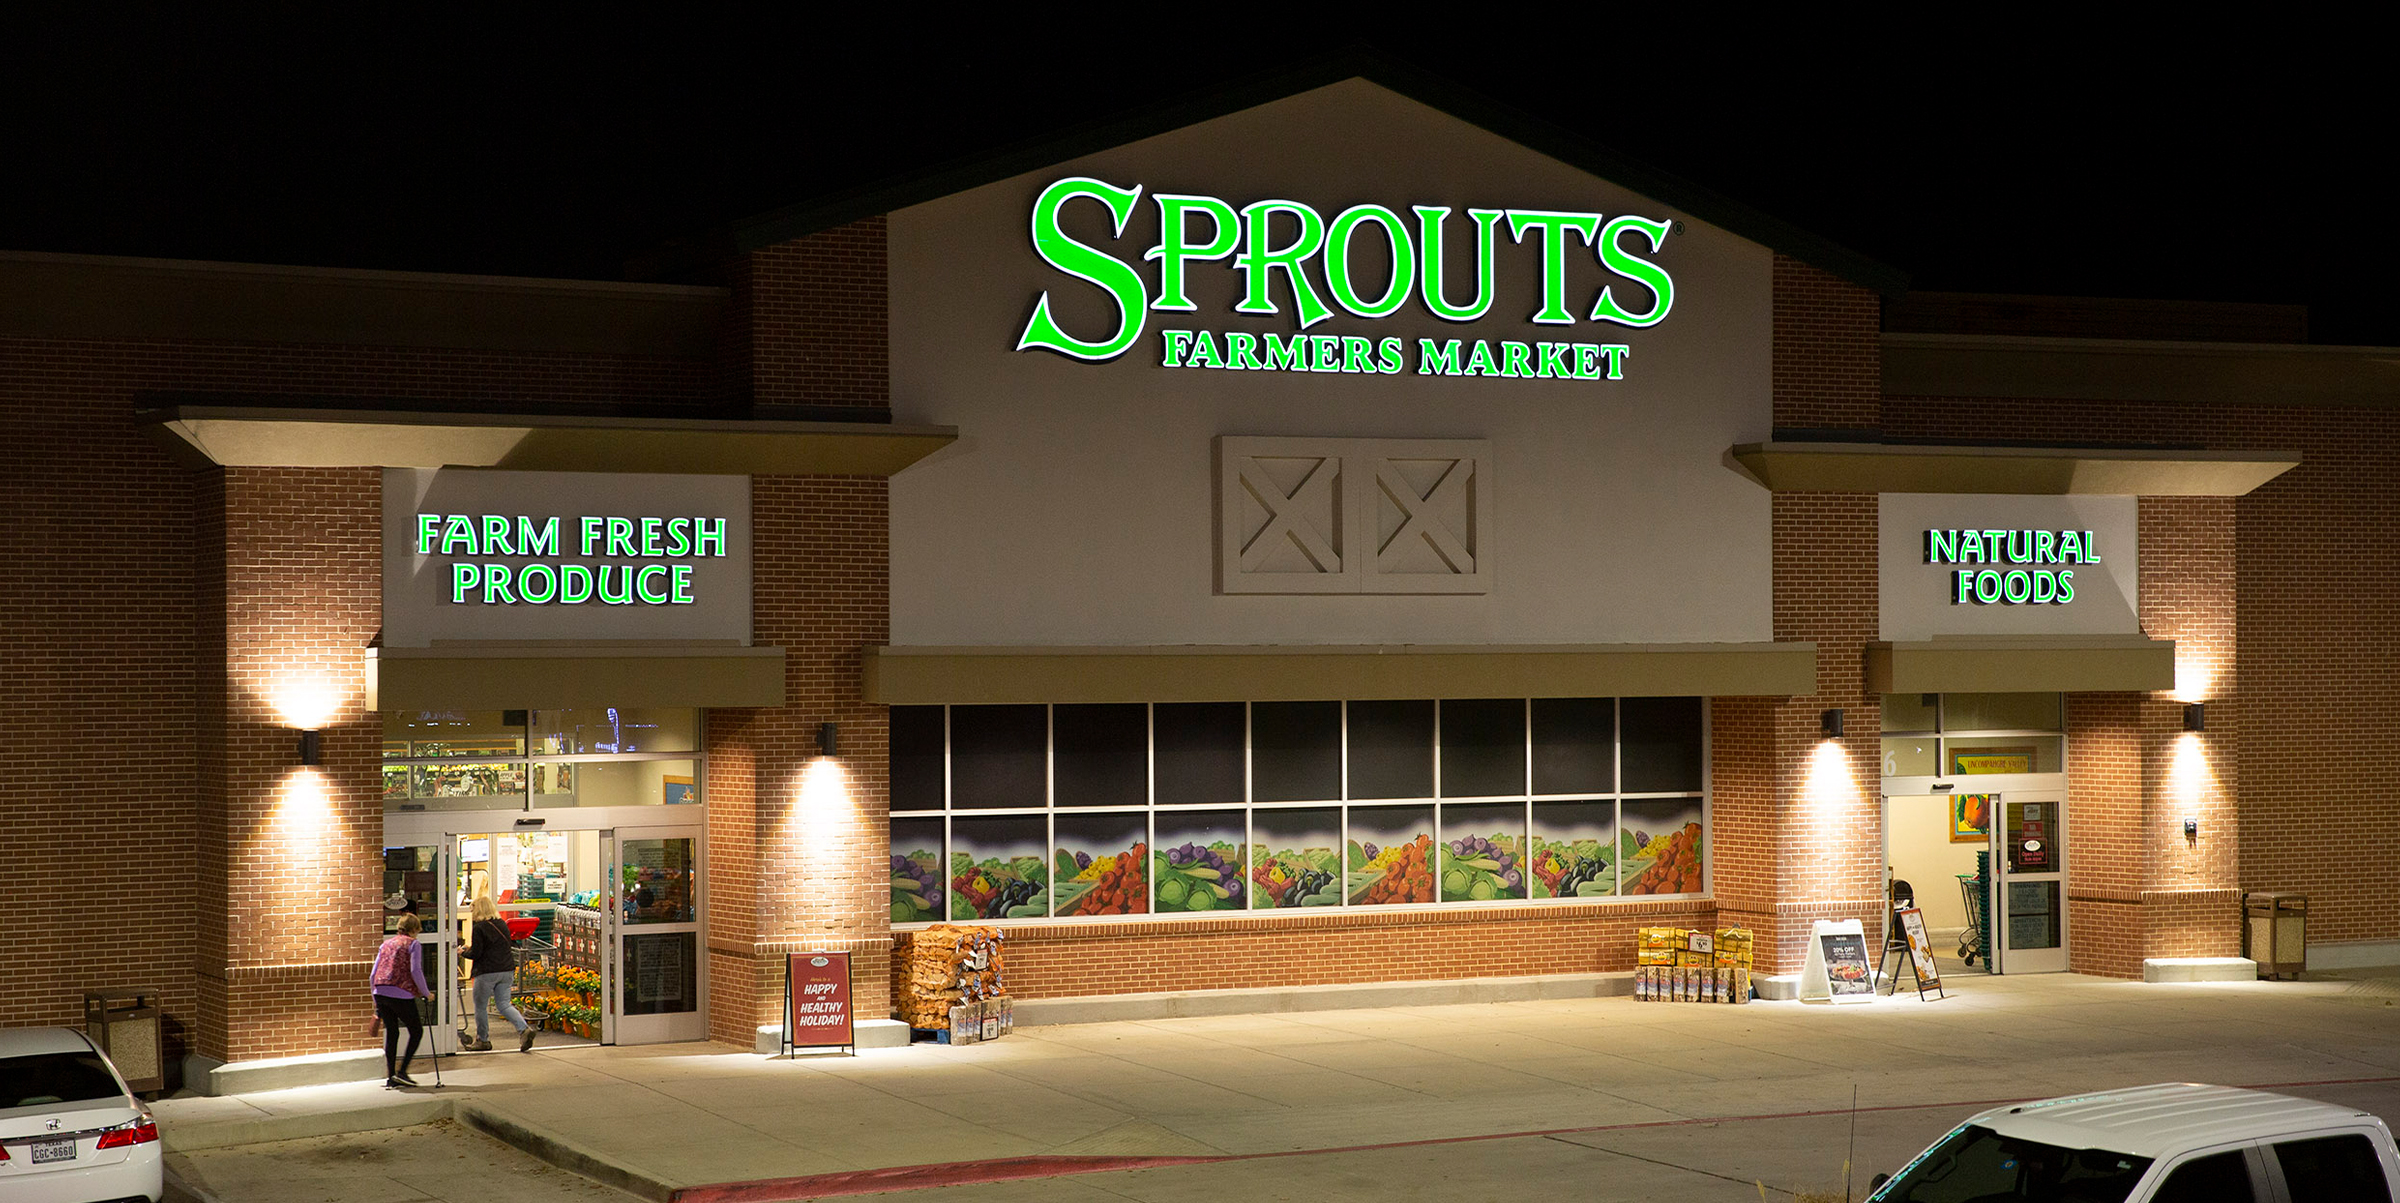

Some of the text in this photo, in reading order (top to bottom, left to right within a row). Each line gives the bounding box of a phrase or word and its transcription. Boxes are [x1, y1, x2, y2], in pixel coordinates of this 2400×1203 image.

[1017, 178, 1674, 359] SPROUTS
[1163, 330, 1629, 380] FARMERS MARKET
[418, 514, 725, 556] FARM FRESH
[1930, 530, 2101, 563] NATURAL
[453, 564, 693, 604] PRODUCE
[1958, 570, 2074, 603] FOODS
[1883, 750, 1896, 777] 6
[805, 984, 837, 995] HAPPY
[800, 1014, 845, 1026] HOLIDAY!
[801, 1002, 843, 1013] HEALTHY
